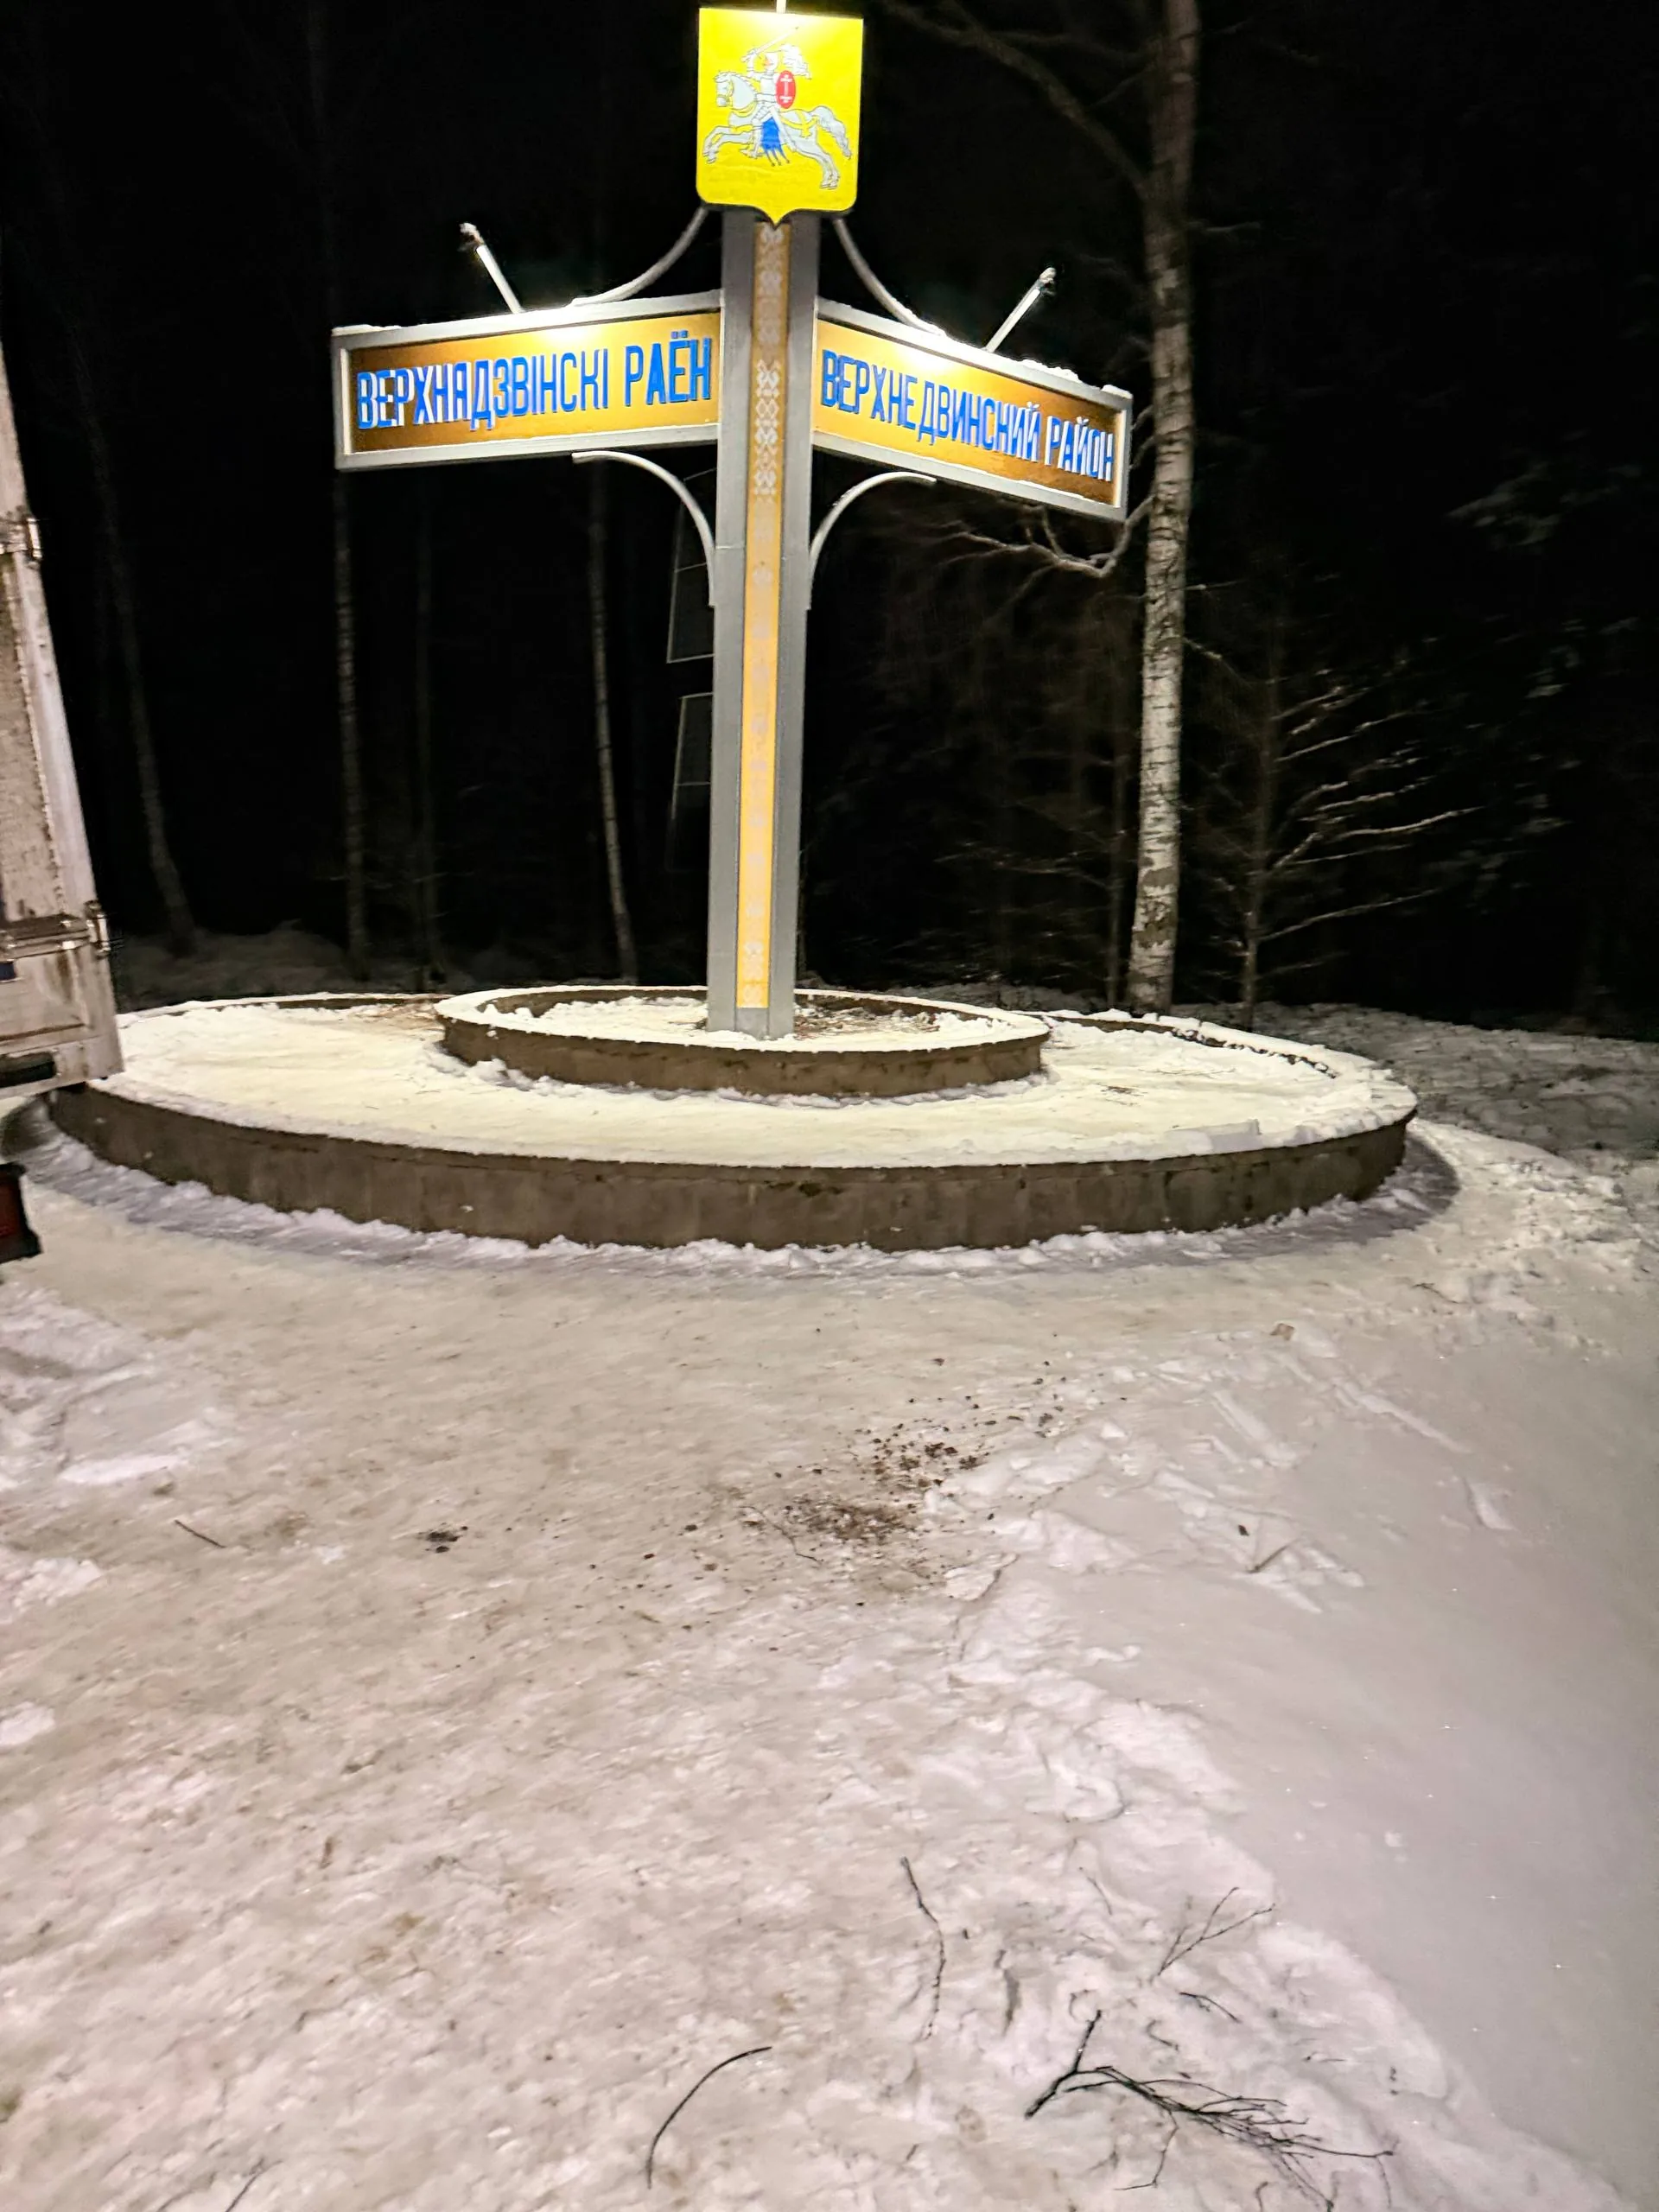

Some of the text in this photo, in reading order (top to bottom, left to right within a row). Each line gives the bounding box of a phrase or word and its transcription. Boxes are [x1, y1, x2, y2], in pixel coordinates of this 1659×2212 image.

[357, 329, 712, 432] ВЕРХНЯДЗВІНСКІ РАЁН
[822, 349, 1114, 482] ВЕРХНЕДВИНСКИЙ РАЙОН
